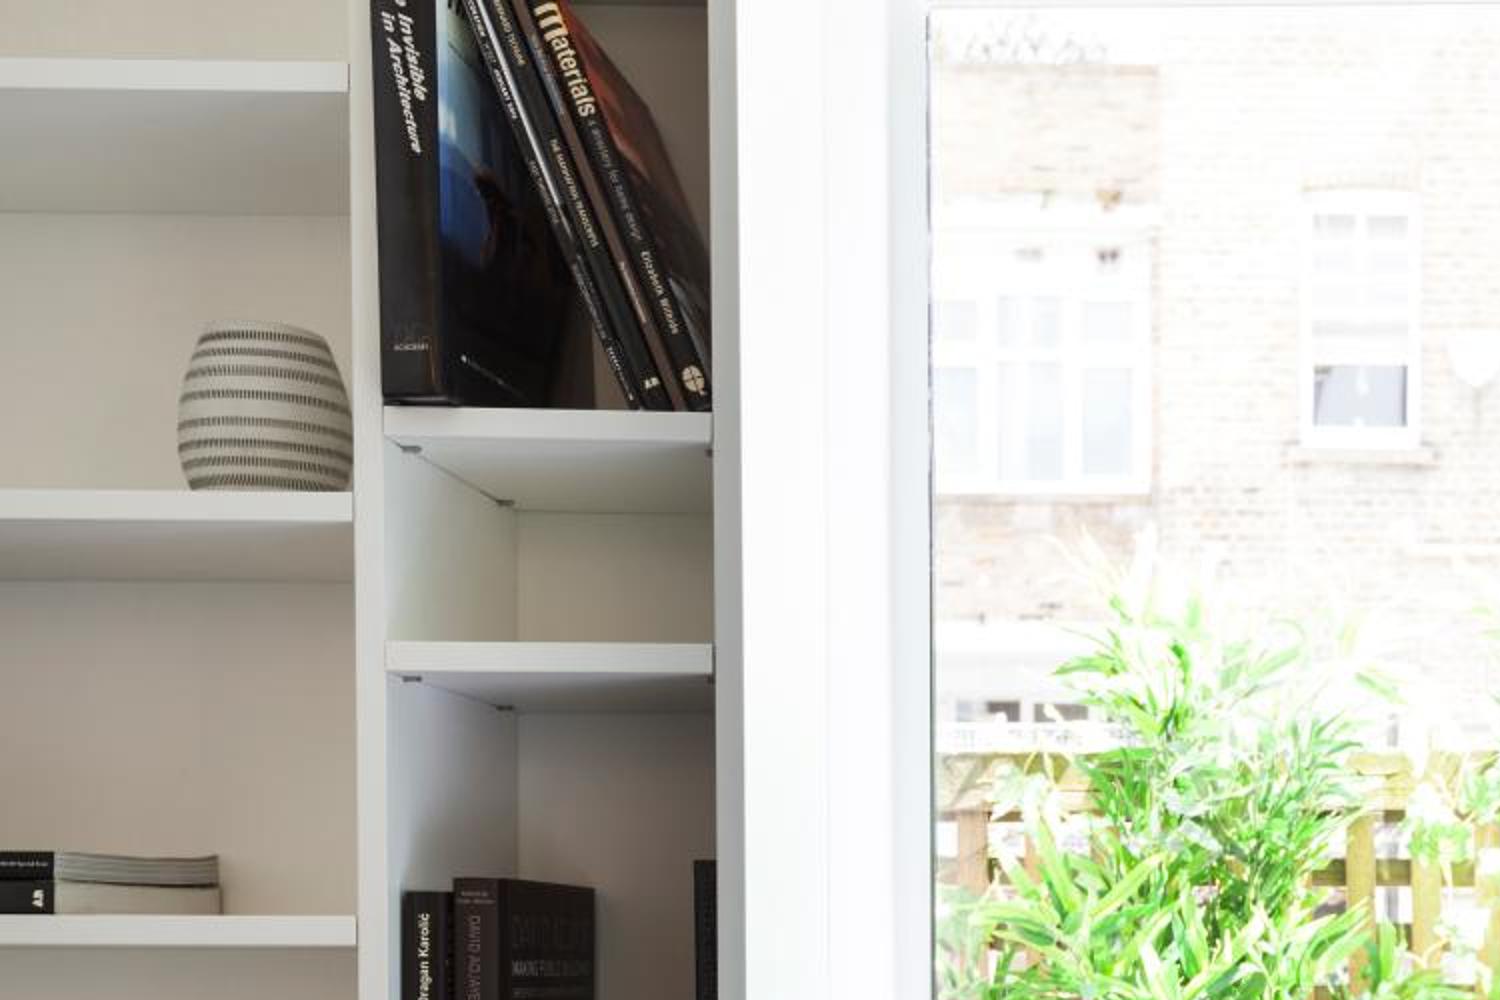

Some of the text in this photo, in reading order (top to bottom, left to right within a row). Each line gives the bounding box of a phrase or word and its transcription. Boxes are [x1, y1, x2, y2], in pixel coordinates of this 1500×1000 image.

[380, 11, 395, 33] in
[397, 12, 428, 102] Invisible
[386, 37, 422, 154] Architecture
[417, 912, 431, 958] Karolić
[468, 915, 481, 952] DAVID
